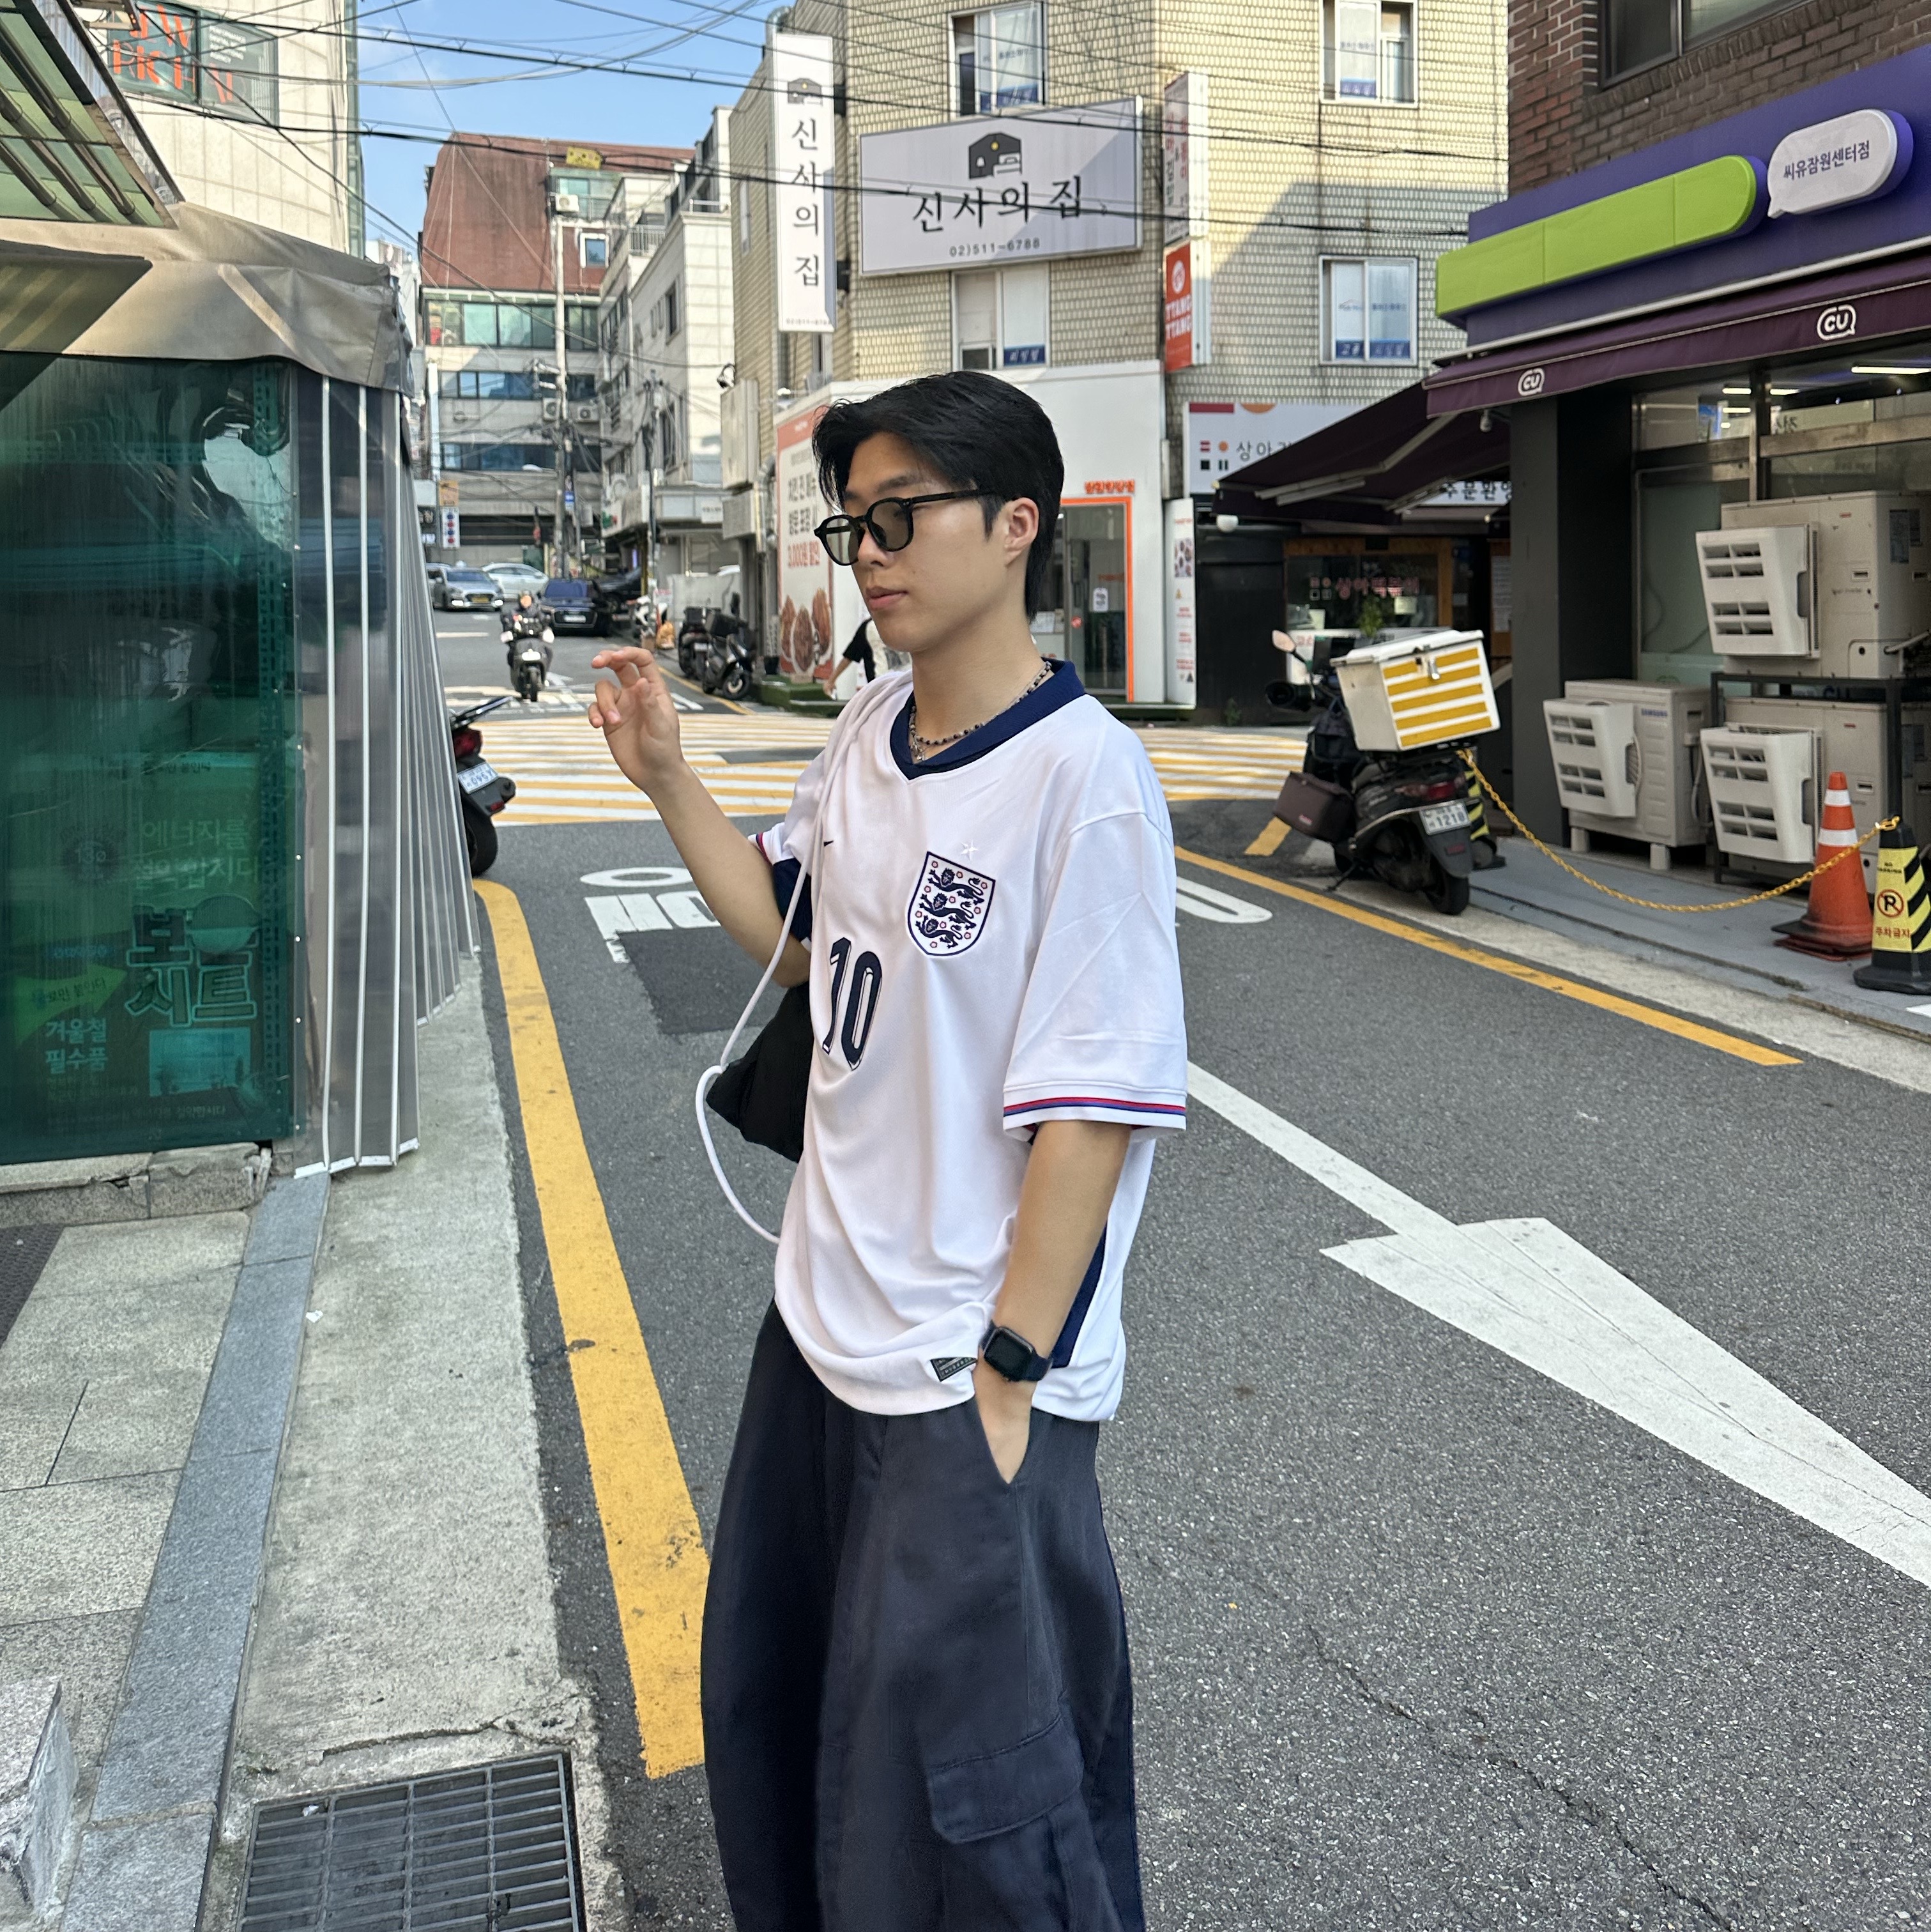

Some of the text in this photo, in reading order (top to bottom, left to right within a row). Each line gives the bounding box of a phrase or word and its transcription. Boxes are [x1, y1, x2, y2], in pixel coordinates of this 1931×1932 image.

[1783, 140, 1870, 180] 씨유잠원센터점
[791, 117, 820, 287] 신사의 집
[913, 176, 1081, 232] 신사의 집
[1641, 708, 1668, 717] SAMSUNG
[1875, 926, 1911, 939] 주차금지
[125, 966, 257, 1027] 시트
[822, 937, 882, 1071] 10
[45, 1020, 107, 1044] 겨울철
[45, 1047, 108, 1075] 필수품
